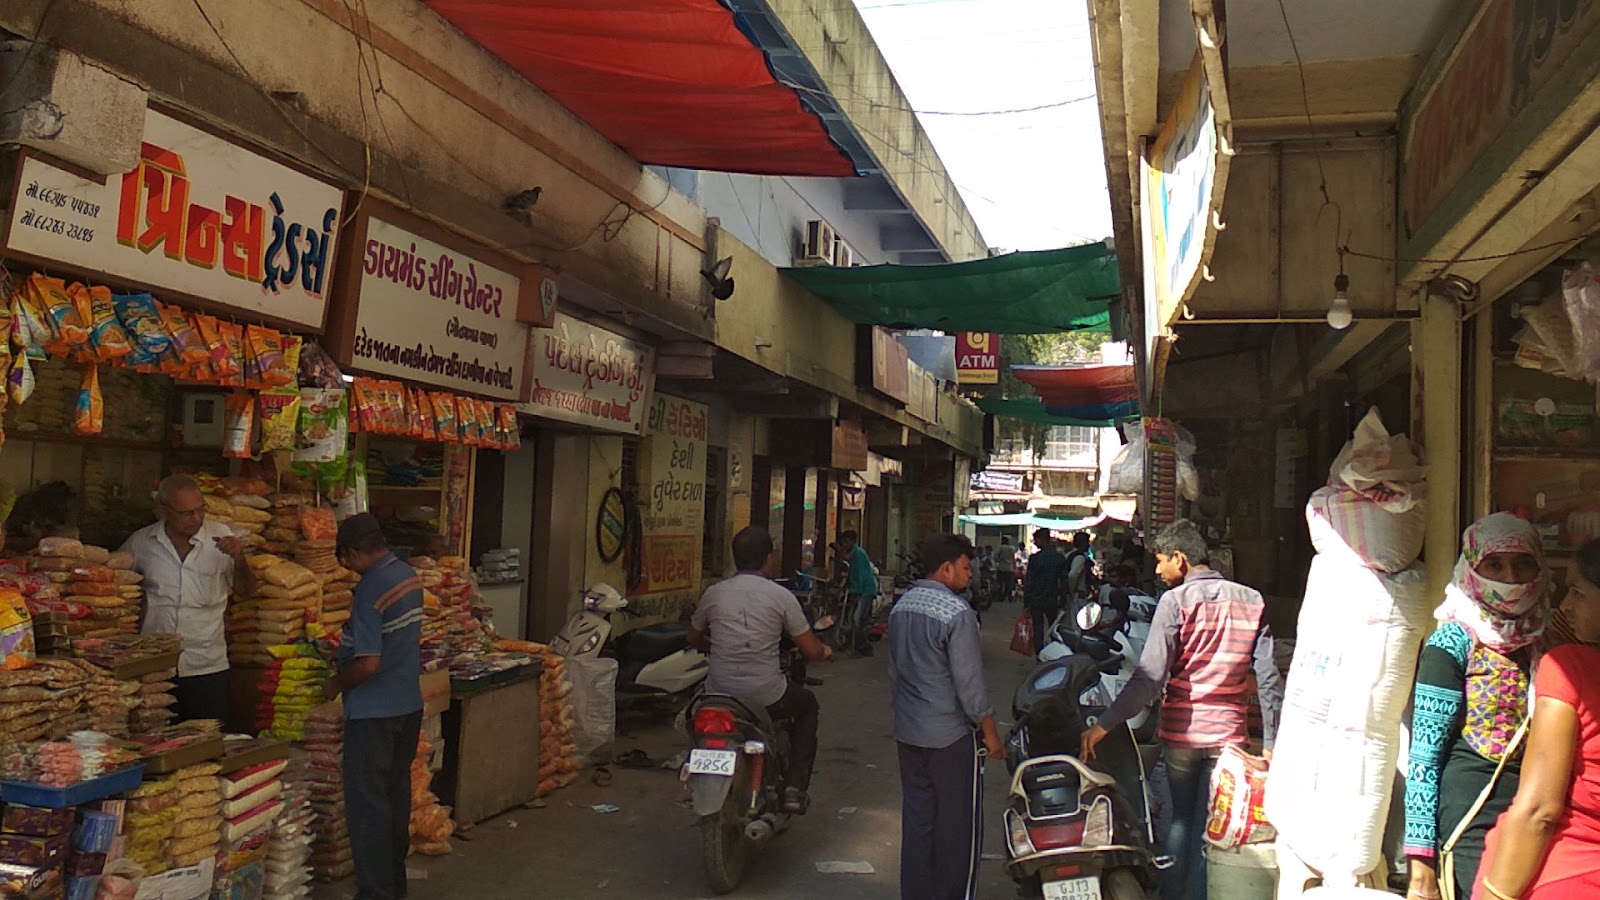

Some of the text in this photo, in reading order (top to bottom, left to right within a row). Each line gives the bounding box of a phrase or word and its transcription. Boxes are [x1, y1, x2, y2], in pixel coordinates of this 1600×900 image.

[363, 239, 426, 291] ડાયમંડ
[428, 254, 463, 305] સીંગ
[463, 263, 503, 318] સેન્ટર
[544, 322, 584, 375] પટેલ
[959, 354, 995, 368] ATM
[670, 439, 694, 471] દેશી
[693, 758, 731, 773] 9856
[1036, 773, 1065, 783] HONDA
